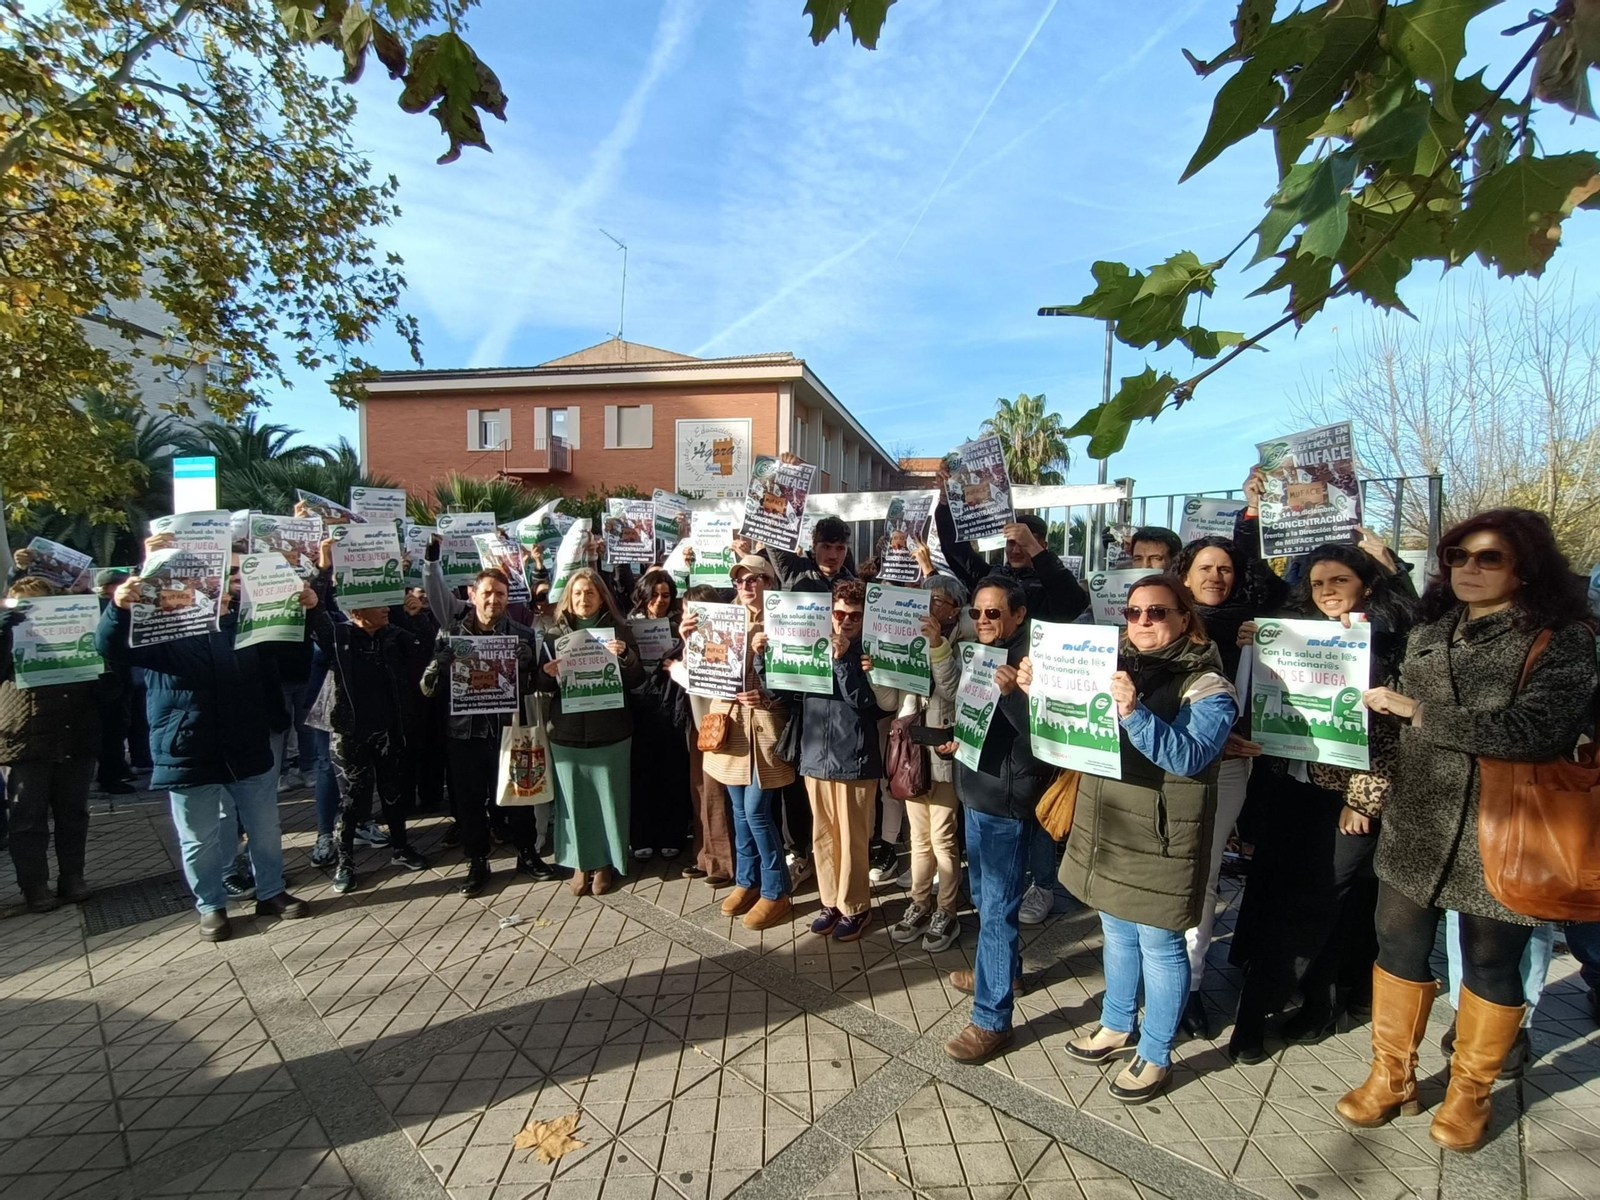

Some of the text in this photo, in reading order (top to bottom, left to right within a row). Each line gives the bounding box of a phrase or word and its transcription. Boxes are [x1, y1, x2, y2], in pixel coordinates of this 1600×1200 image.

[1335, 426, 1348, 435] EN
[990, 438, 998, 446] EN
[1336, 435, 1349, 444] DE
[691, 440, 735, 462] Ágora
[1293, 446, 1350, 467] MUFACE
[966, 454, 1002, 472] MUFACE
[775, 475, 809, 491] MUFACE
[1290, 488, 1321, 499] MUFACE
[960, 505, 1005, 521] CONCENTRACIÓN
[1262, 510, 1276, 519] CSIF
[992, 520, 1006, 528] Madrid
[1272, 513, 1350, 530] CONCENTRACIÓN
[1190, 531, 1200, 540] NO
[1299, 526, 1331, 535] Dirección
[281, 532, 320, 541] MUFACE
[1284, 537, 1314, 545] MUFACE
[1325, 533, 1351, 541] Madrid
[182, 542, 219, 550] SE JUEGA
[368, 552, 390, 561] JUEGA
[170, 567, 221, 578] MUFACE
[253, 585, 297, 598] NO SE JUEGA
[55, 604, 98, 612] muface
[796, 603, 830, 611] muface
[895, 599, 928, 610] muface
[1104, 607, 1115, 615] NO
[26, 626, 86, 637] NO SE JUEGA
[775, 627, 820, 638] NO SE JUEGA
[873, 622, 918, 636] NO SE JUEGA
[1261, 629, 1282, 638] CSIF
[1034, 631, 1044, 640] CSIF
[1062, 640, 1115, 653] muface
[1306, 636, 1367, 649] muface
[479, 650, 516, 659] MUFACE
[1262, 648, 1279, 656] Con
[1295, 650, 1322, 659] salud
[1325, 651, 1338, 660] de
[1342, 653, 1357, 661] l@s
[1054, 656, 1075, 664] salud
[1078, 657, 1089, 665] de
[1092, 658, 1106, 666] l@s
[1278, 658, 1339, 670] funcionari@s
[1042, 662, 1090, 676] funcionari@s
[1039, 673, 1098, 692] NO SE JUEGA
[1270, 669, 1347, 687] NO SE JUEGA
[963, 685, 993, 700] NO SE JUEGA
